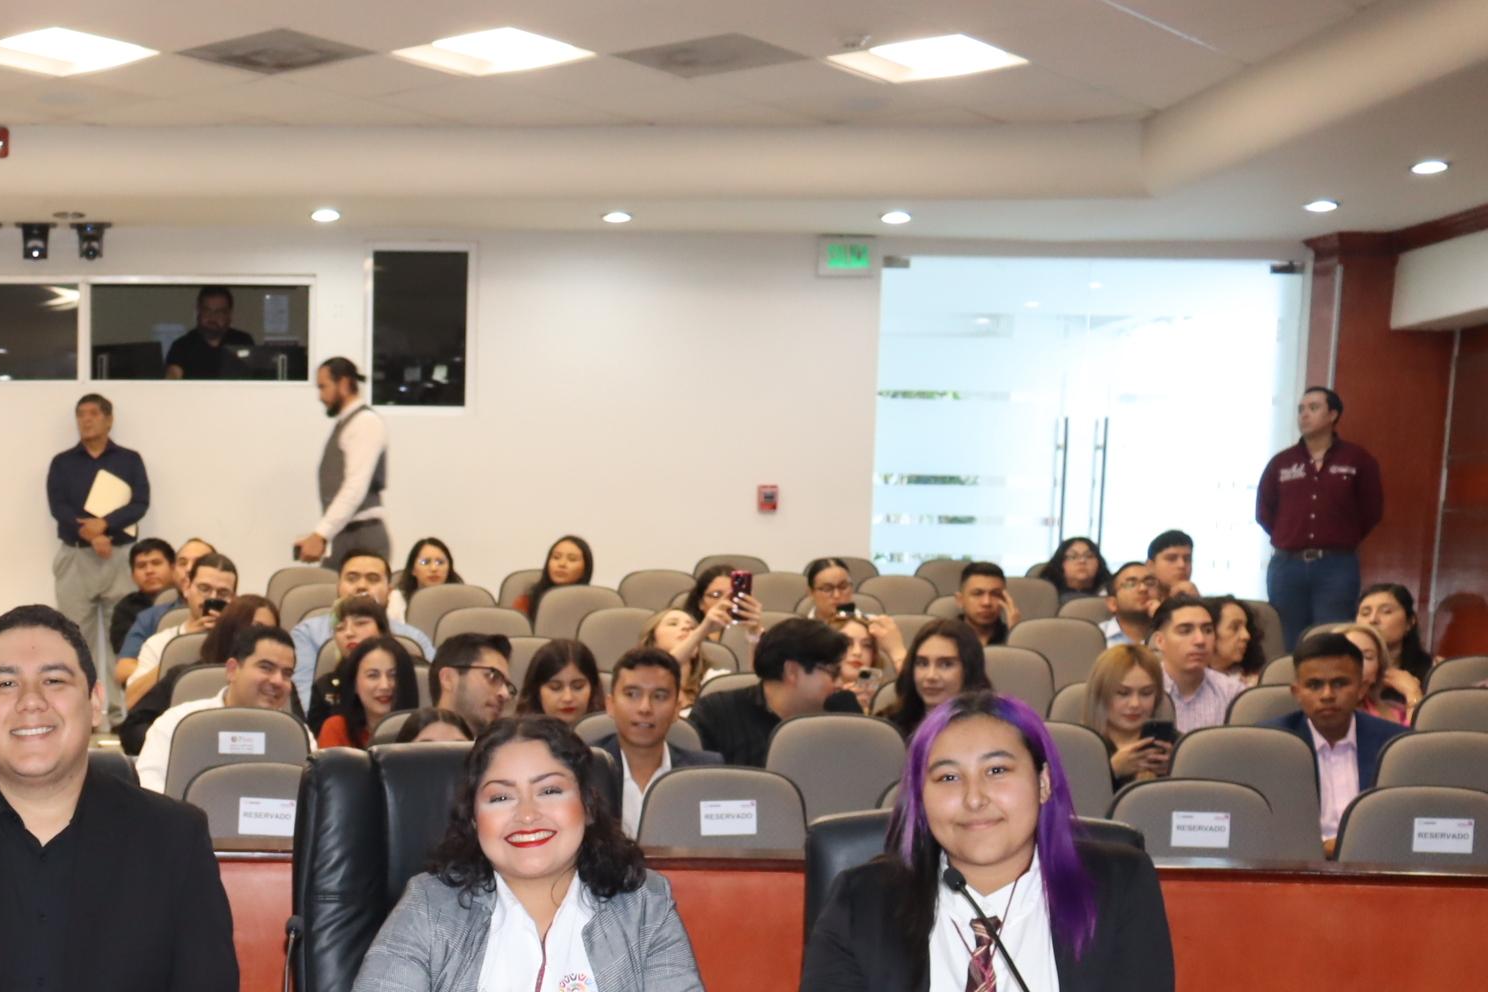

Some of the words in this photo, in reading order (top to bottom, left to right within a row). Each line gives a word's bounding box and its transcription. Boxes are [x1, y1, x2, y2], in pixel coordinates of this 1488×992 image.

[243, 811, 292, 820] RESERVADO
[704, 812, 753, 820] RESERVADO
[1176, 824, 1227, 833] RESERVADO
[1417, 831, 1470, 841] RESERVADO
